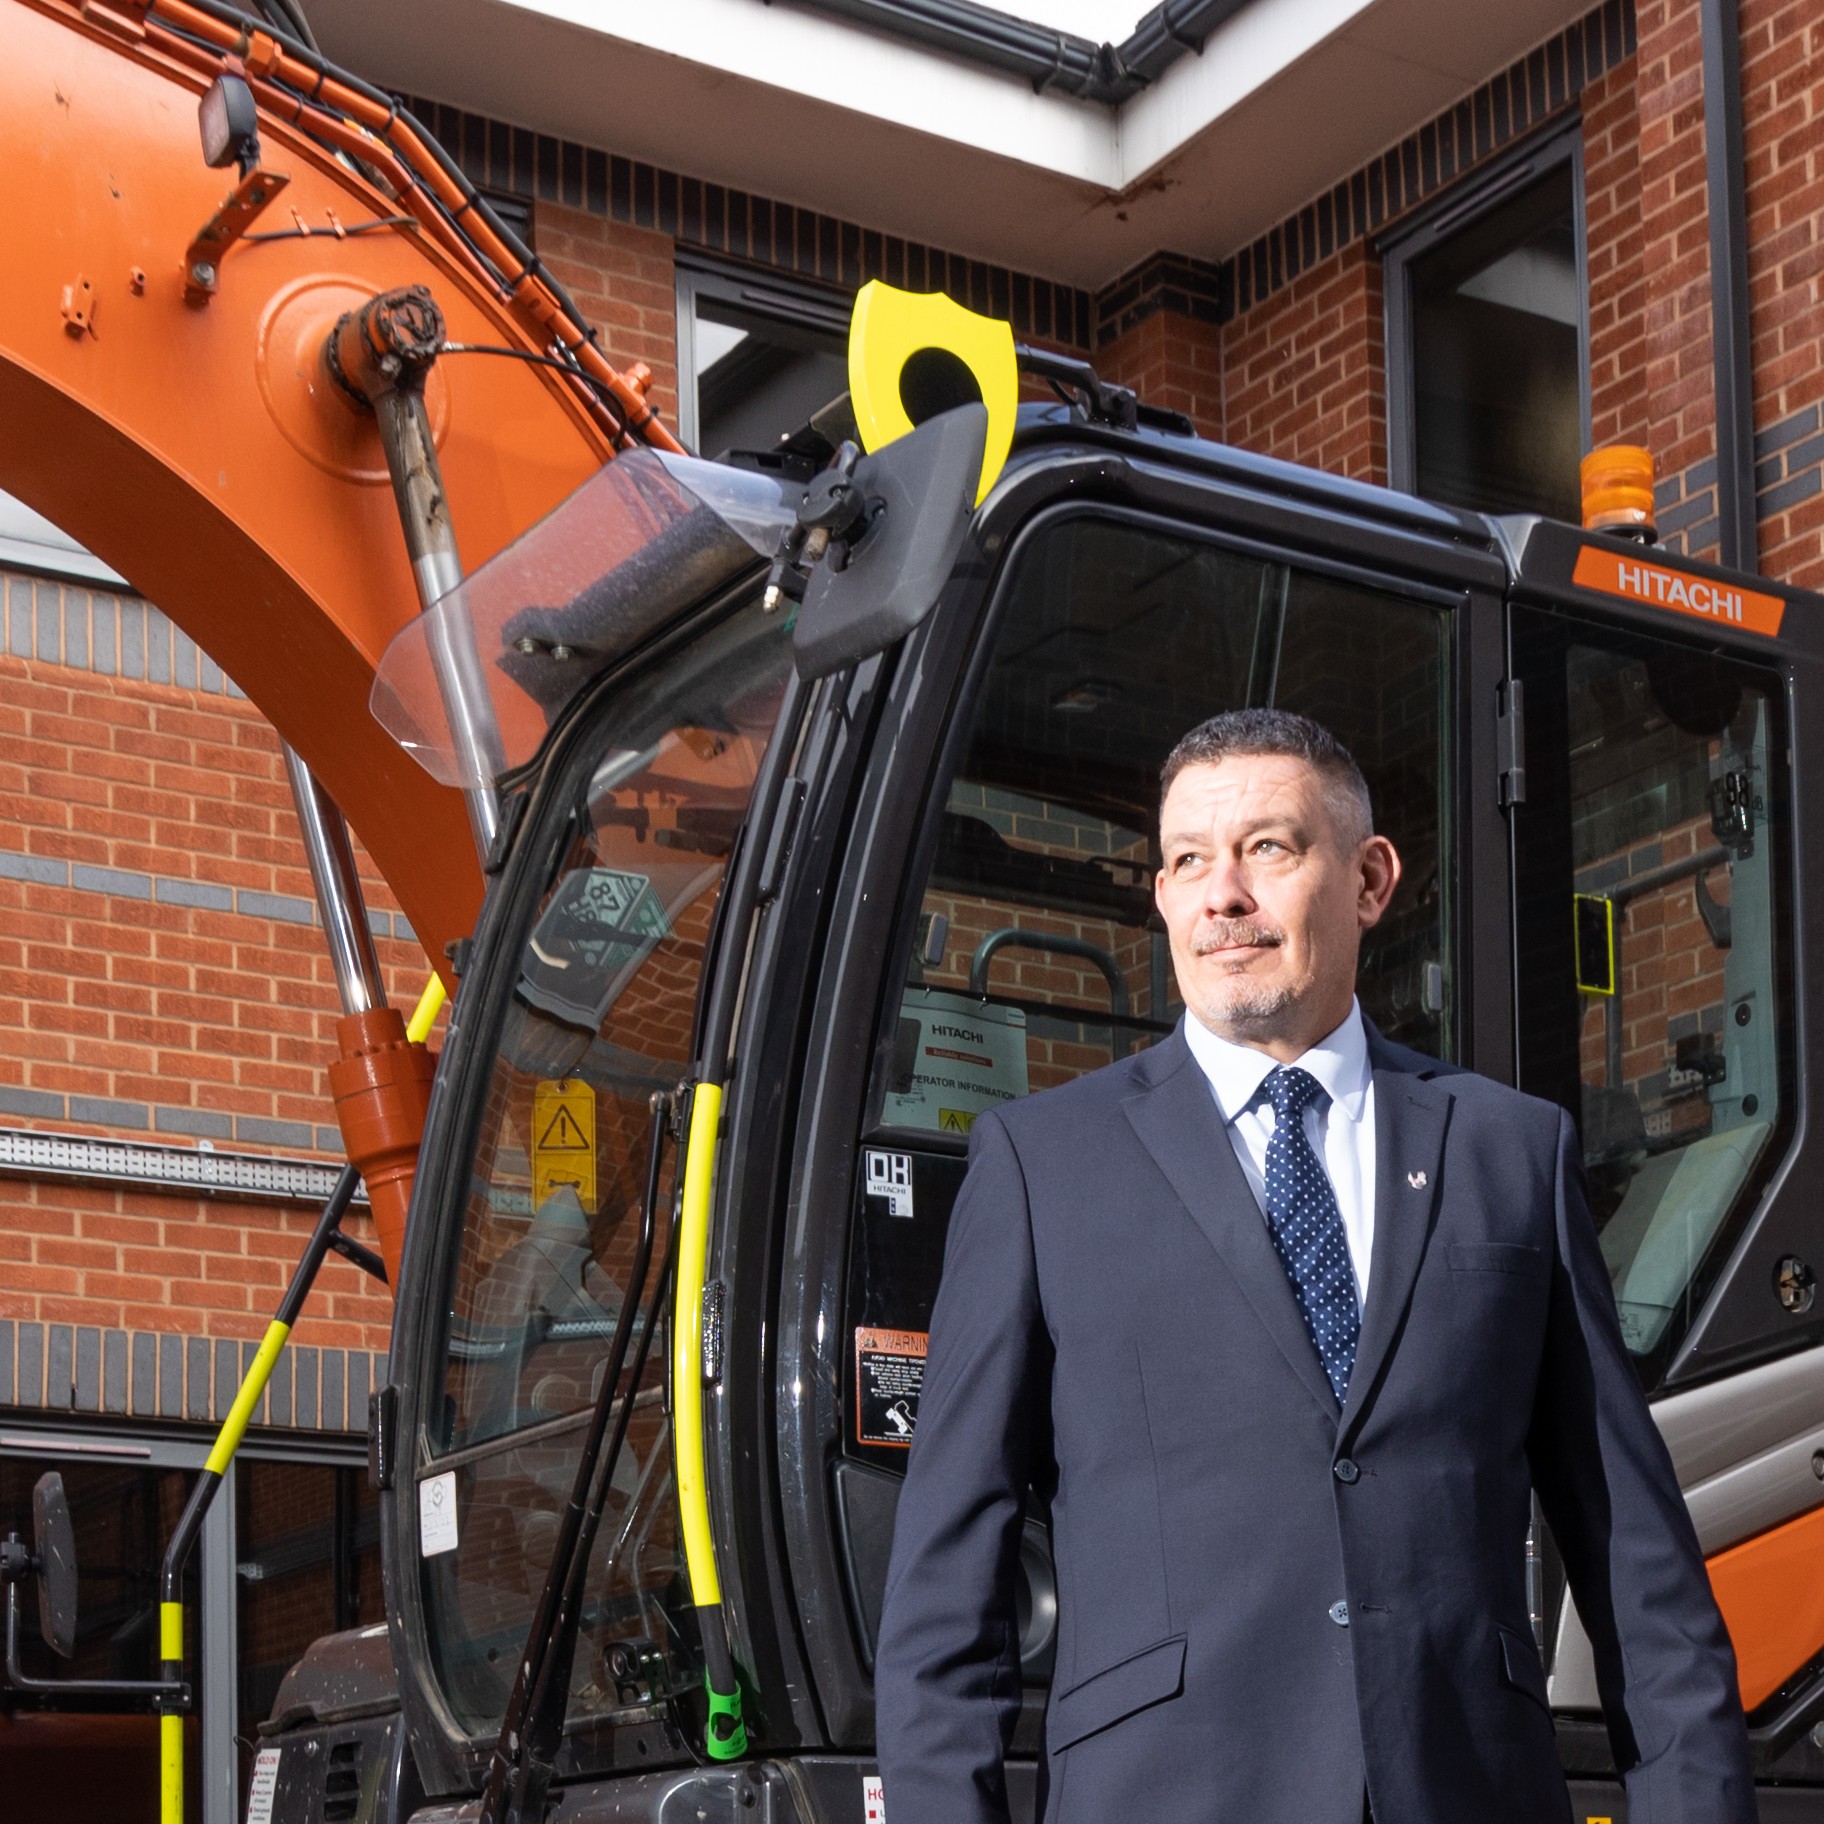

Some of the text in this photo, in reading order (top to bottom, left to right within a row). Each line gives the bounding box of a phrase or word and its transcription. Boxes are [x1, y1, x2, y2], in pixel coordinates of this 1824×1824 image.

[1618, 562, 1742, 622] HITACHI
[590, 882, 621, 911] 87
[932, 1024, 984, 1045] HITACHI
[902, 1072, 1016, 1100] OPERATOR INFORMATION
[873, 1184, 907, 1195] HITACHI
[884, 1333, 928, 1353] WARNIN
